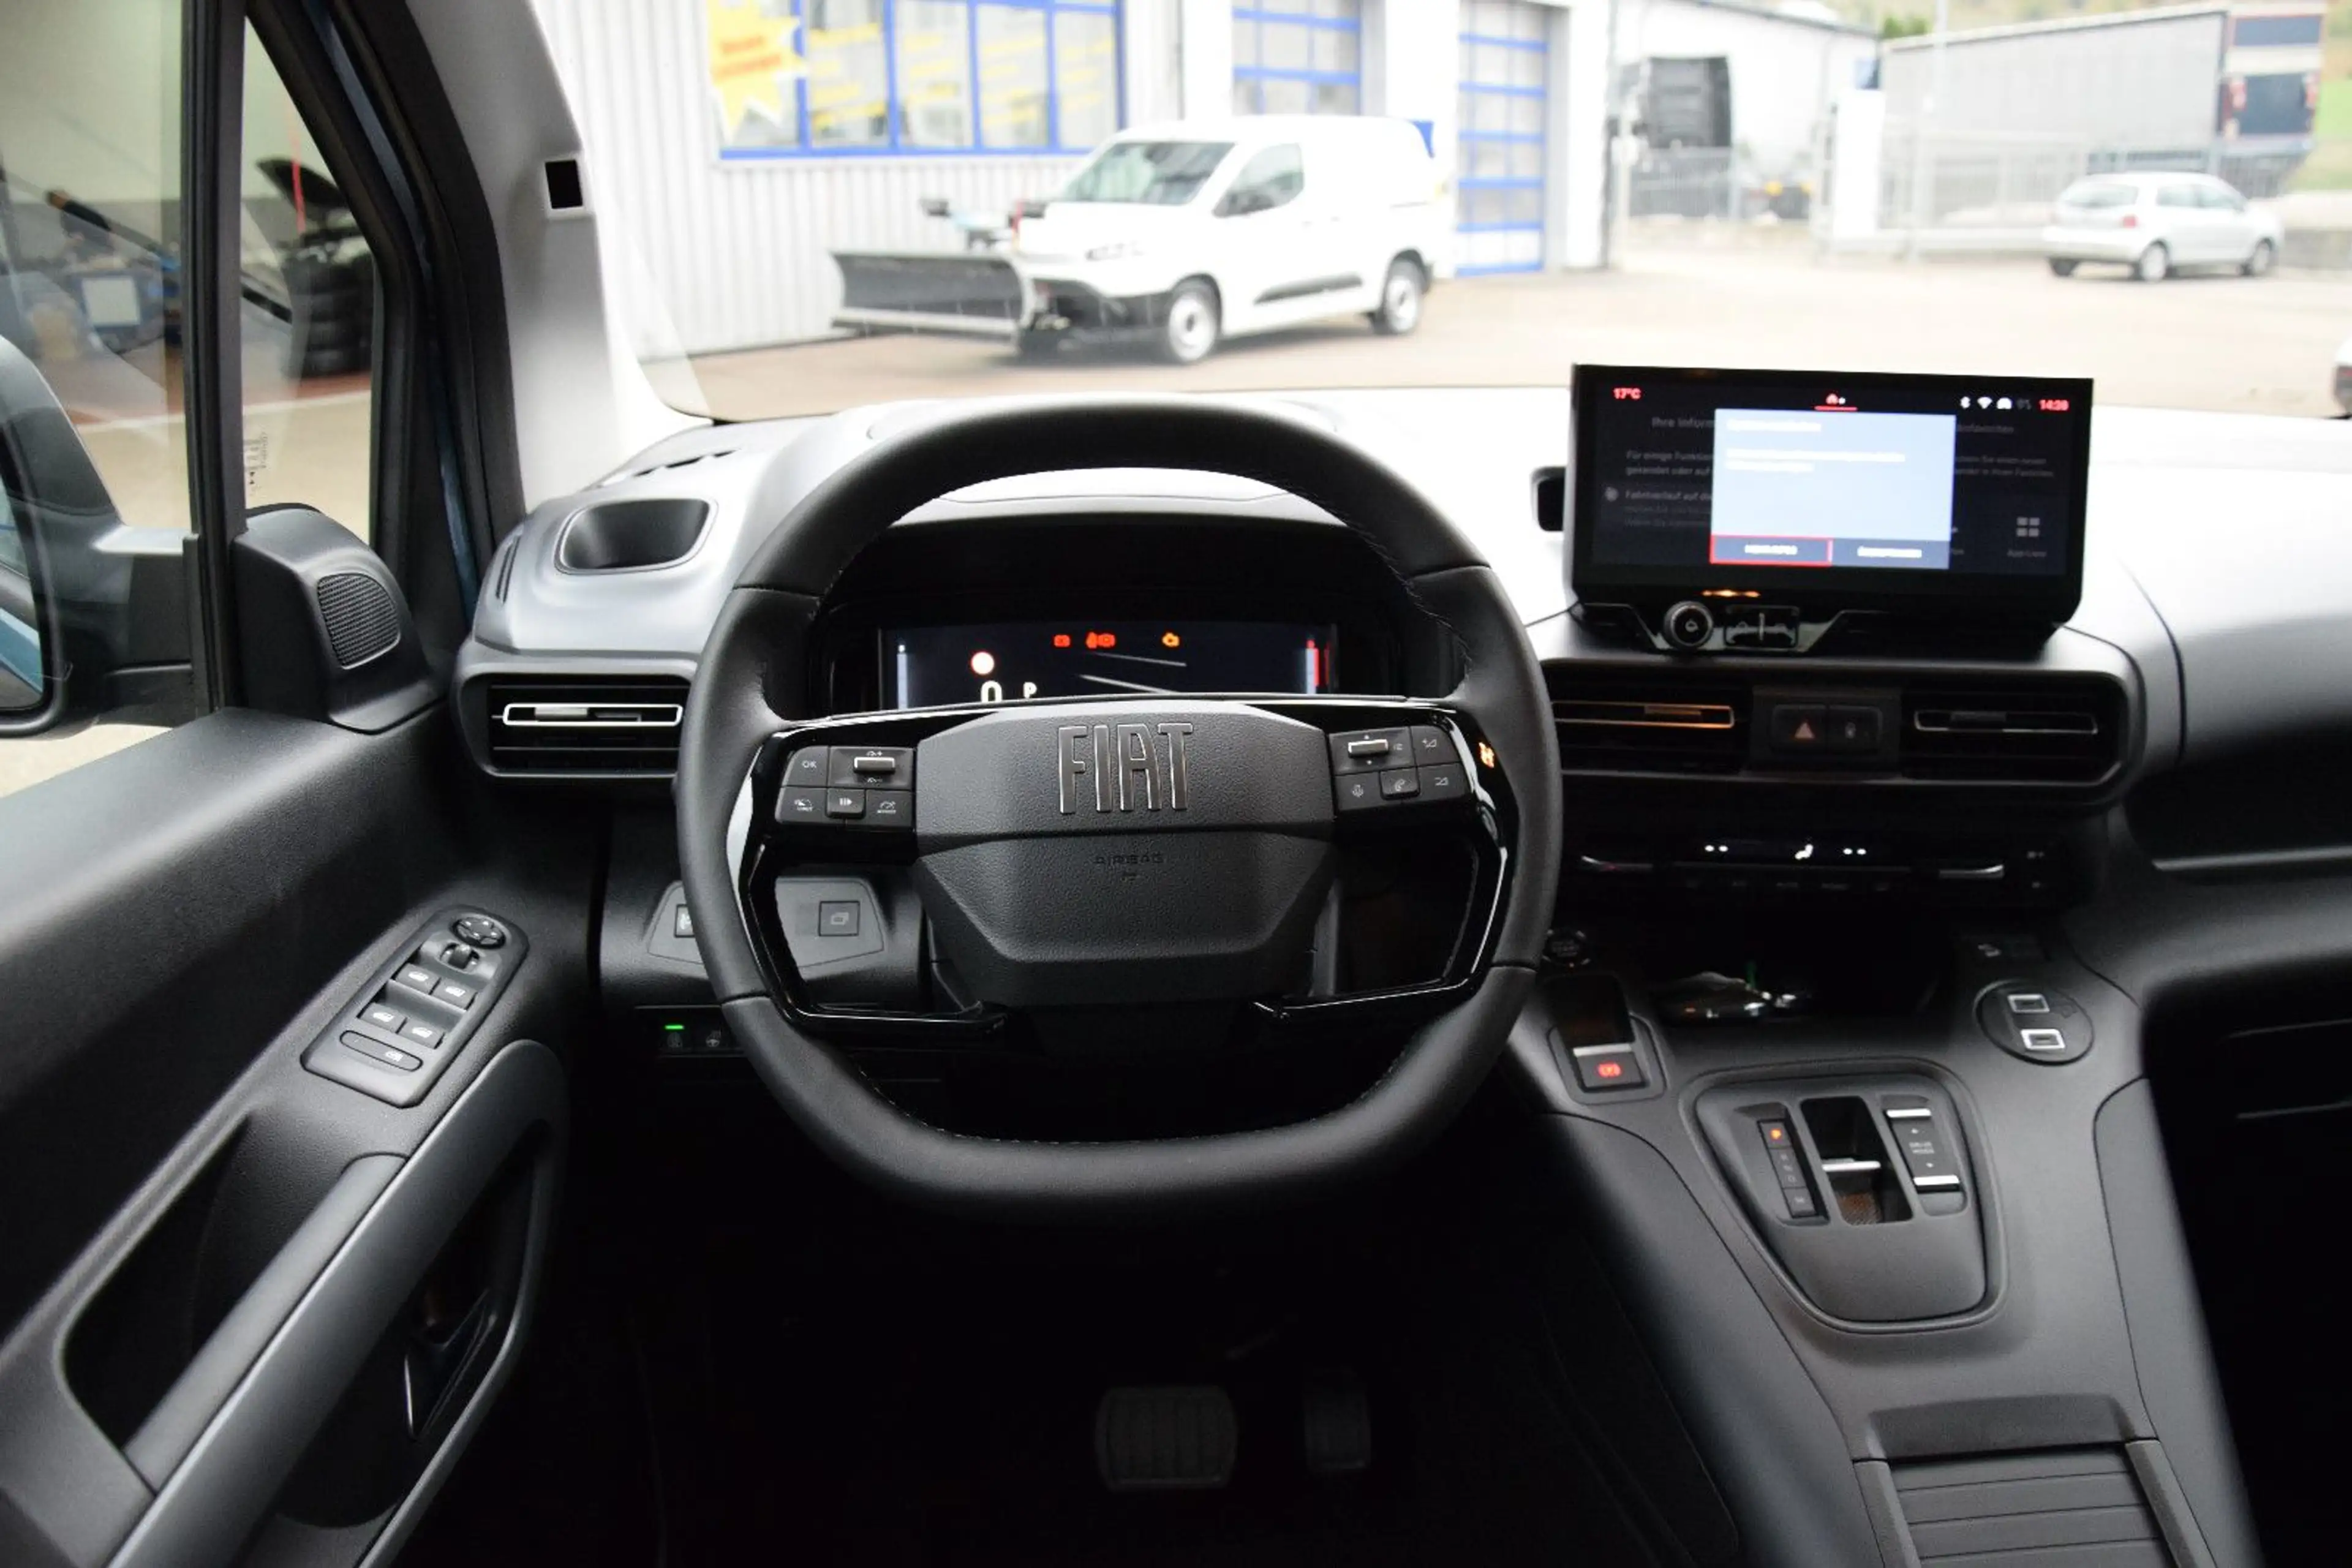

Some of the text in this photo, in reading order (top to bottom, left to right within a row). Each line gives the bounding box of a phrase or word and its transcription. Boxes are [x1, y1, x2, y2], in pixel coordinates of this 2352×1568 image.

[1023, 681, 1038, 699] P
[802, 760, 818, 769] OK
[1058, 723, 1193, 814] FIAT
